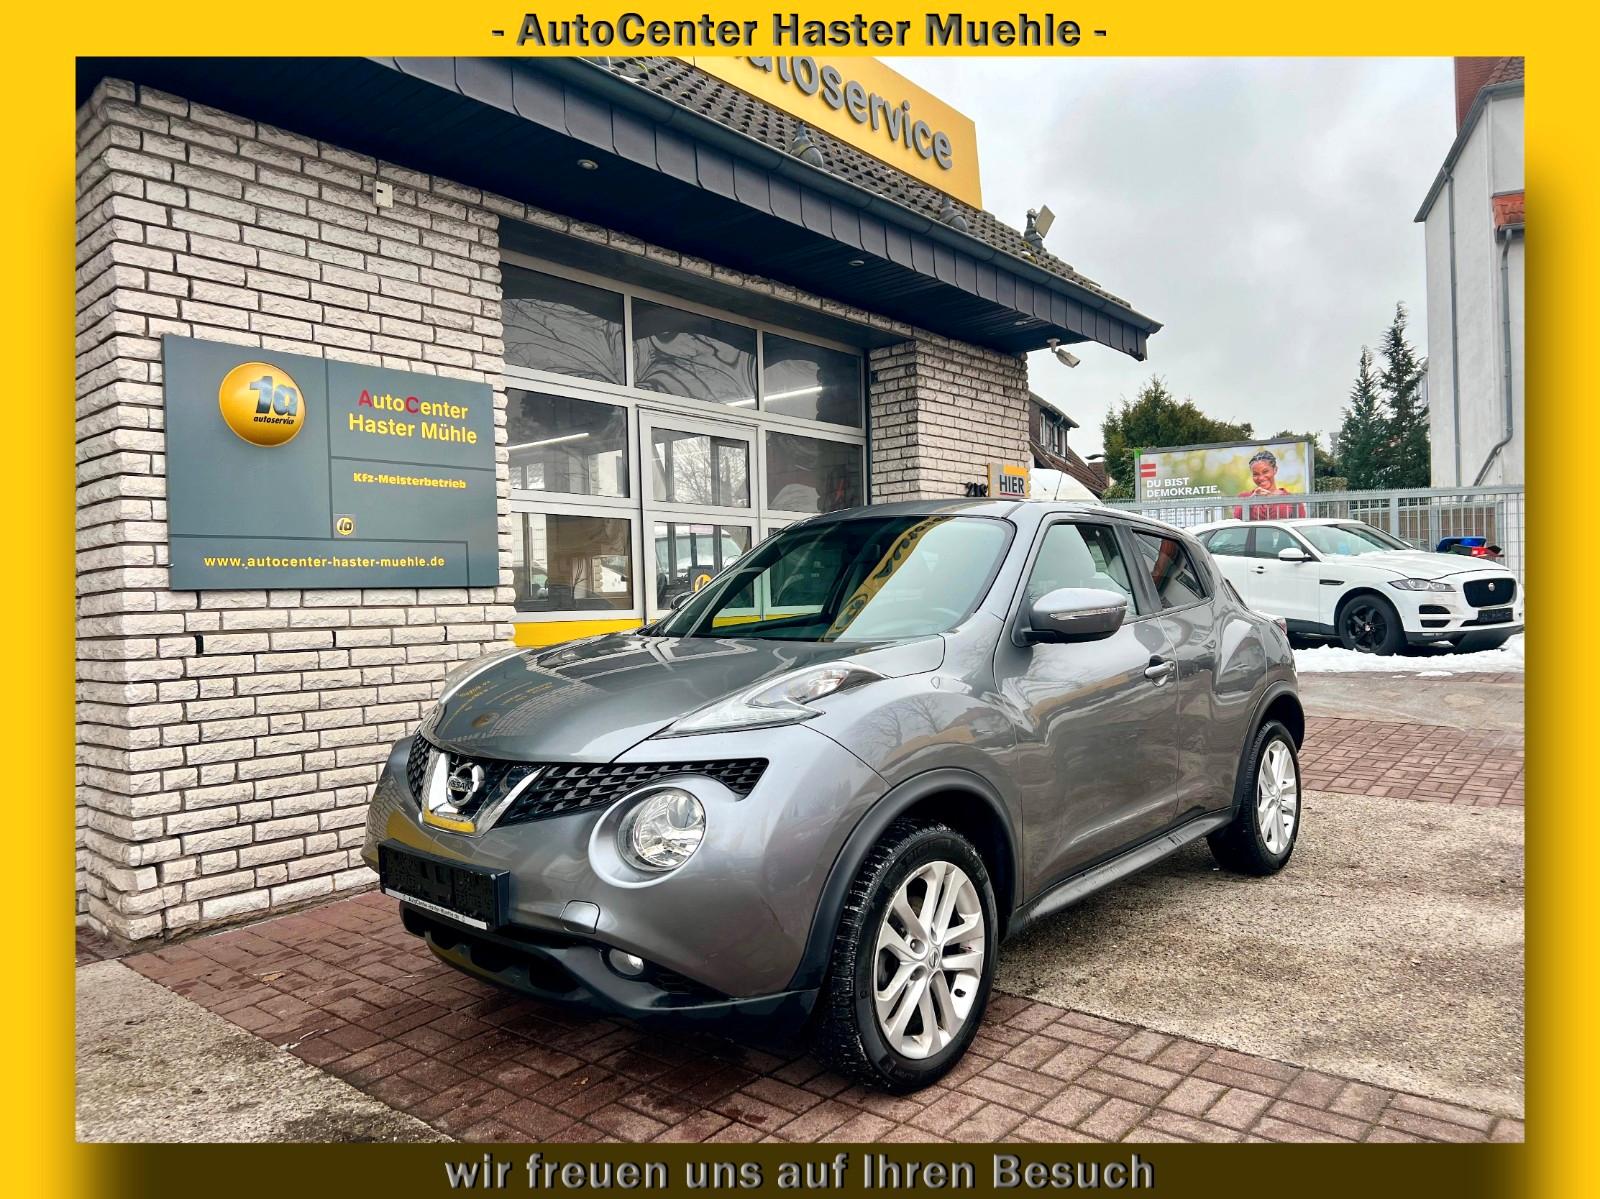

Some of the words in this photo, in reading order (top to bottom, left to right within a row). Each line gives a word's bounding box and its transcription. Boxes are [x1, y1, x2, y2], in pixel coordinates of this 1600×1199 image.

[249, 375, 298, 417] 1a
[358, 389, 468, 419] AutoCenter
[253, 415, 295, 425] autoservice
[349, 413, 415, 437] Haster
[421, 421, 477, 444] Mühle
[353, 472, 467, 488] Kfz-Meisterbetrieb
[999, 474, 1025, 494] HIER
[1146, 479, 1161, 488] DU
[1164, 477, 1190, 487] BIST
[1146, 485, 1221, 498] DEMOKRATIE.
[203, 555, 446, 568] www.autocenter-haster-muehle.de
